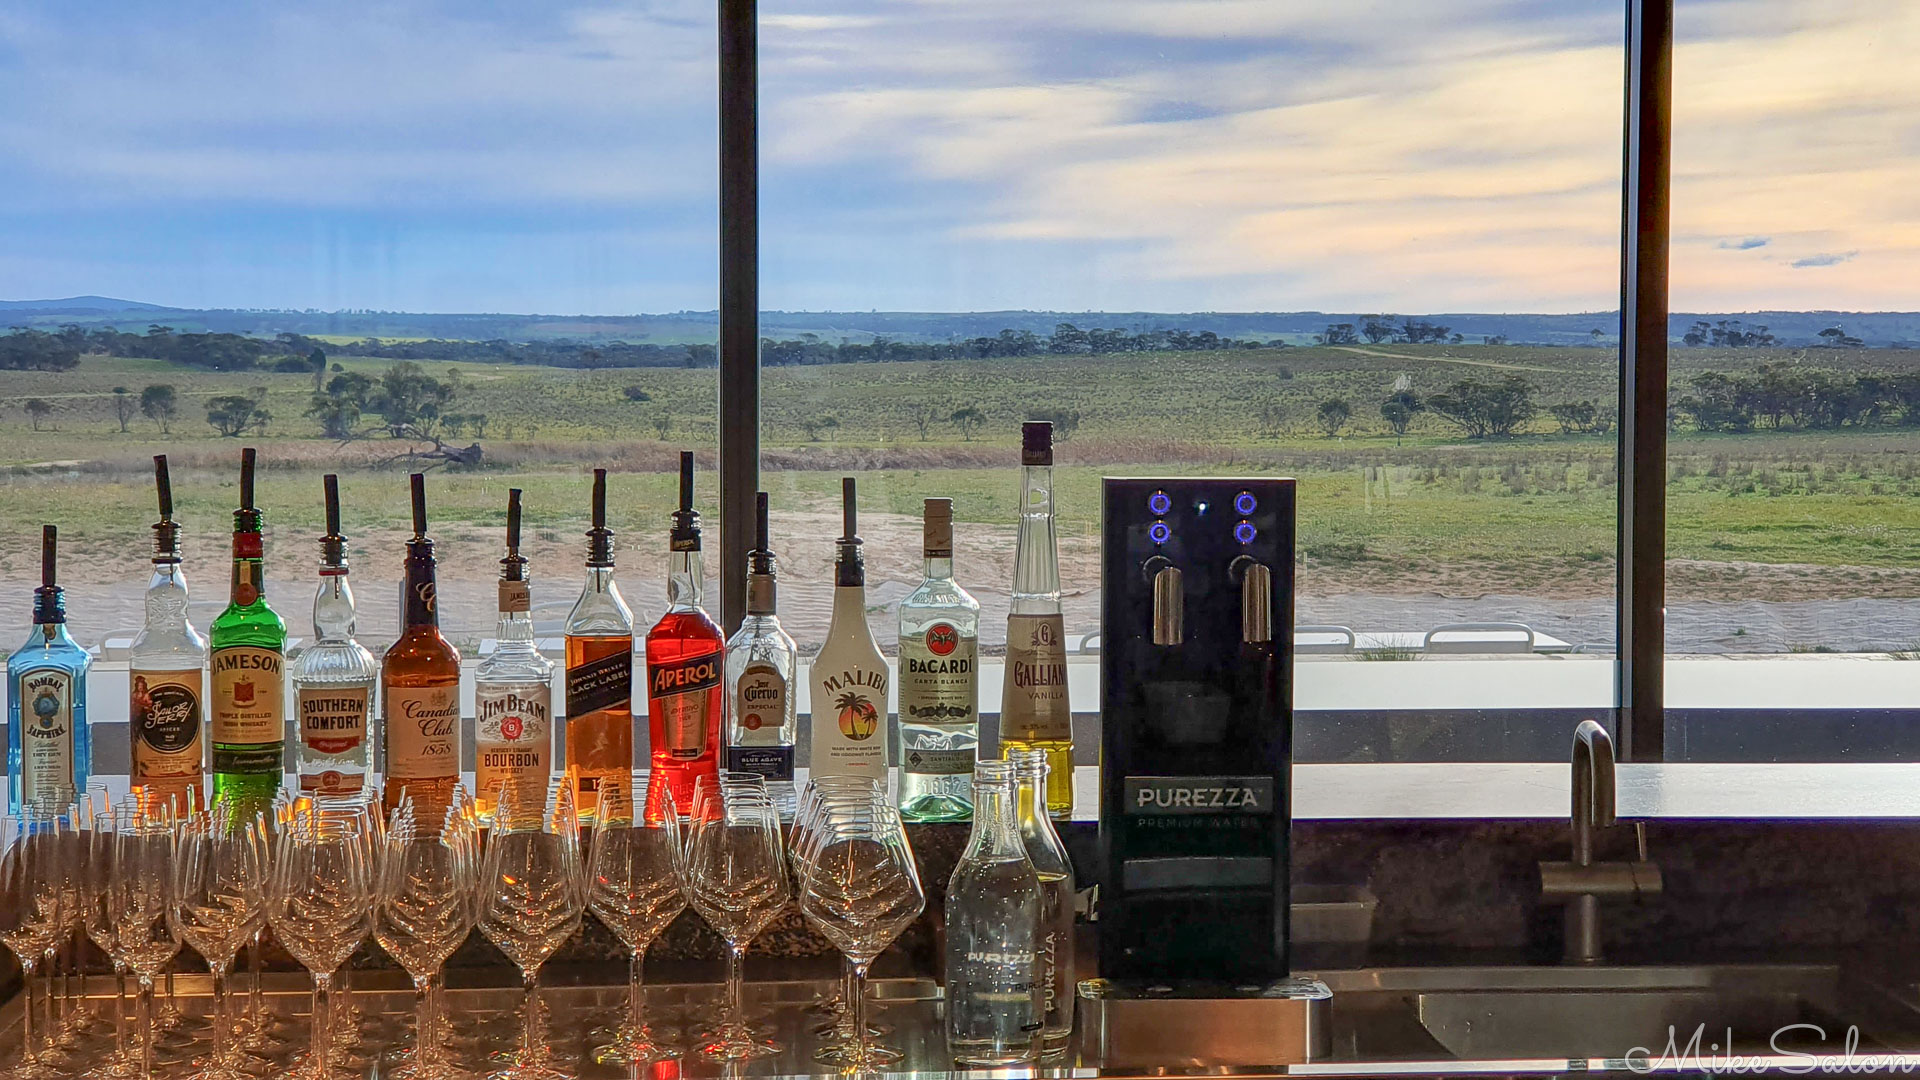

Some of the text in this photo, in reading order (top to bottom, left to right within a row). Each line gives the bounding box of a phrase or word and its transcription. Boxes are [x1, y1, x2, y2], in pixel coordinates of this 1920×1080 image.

[212, 654, 281, 675] JAMESON
[909, 655, 972, 673] BACARDÍ
[28, 677, 64, 692] BOMBAY
[599, 670, 629, 685] LABEL
[654, 662, 717, 692] APEROL
[822, 669, 888, 697] MALIBU
[744, 685, 778, 702] Cuervo
[1028, 691, 1064, 700] VANILLA
[303, 699, 364, 714] SOUTHERN
[480, 694, 546, 723] JIM BEAM
[27, 723, 67, 739] SAPPHIRE
[306, 715, 361, 730] COMFORT
[418, 718, 454, 736] Club
[421, 743, 452, 756] 1858
[484, 753, 539, 767] BOURBON
[1137, 788, 1259, 807] PUREZZA
[1044, 931, 1055, 1012] PUREZZA
